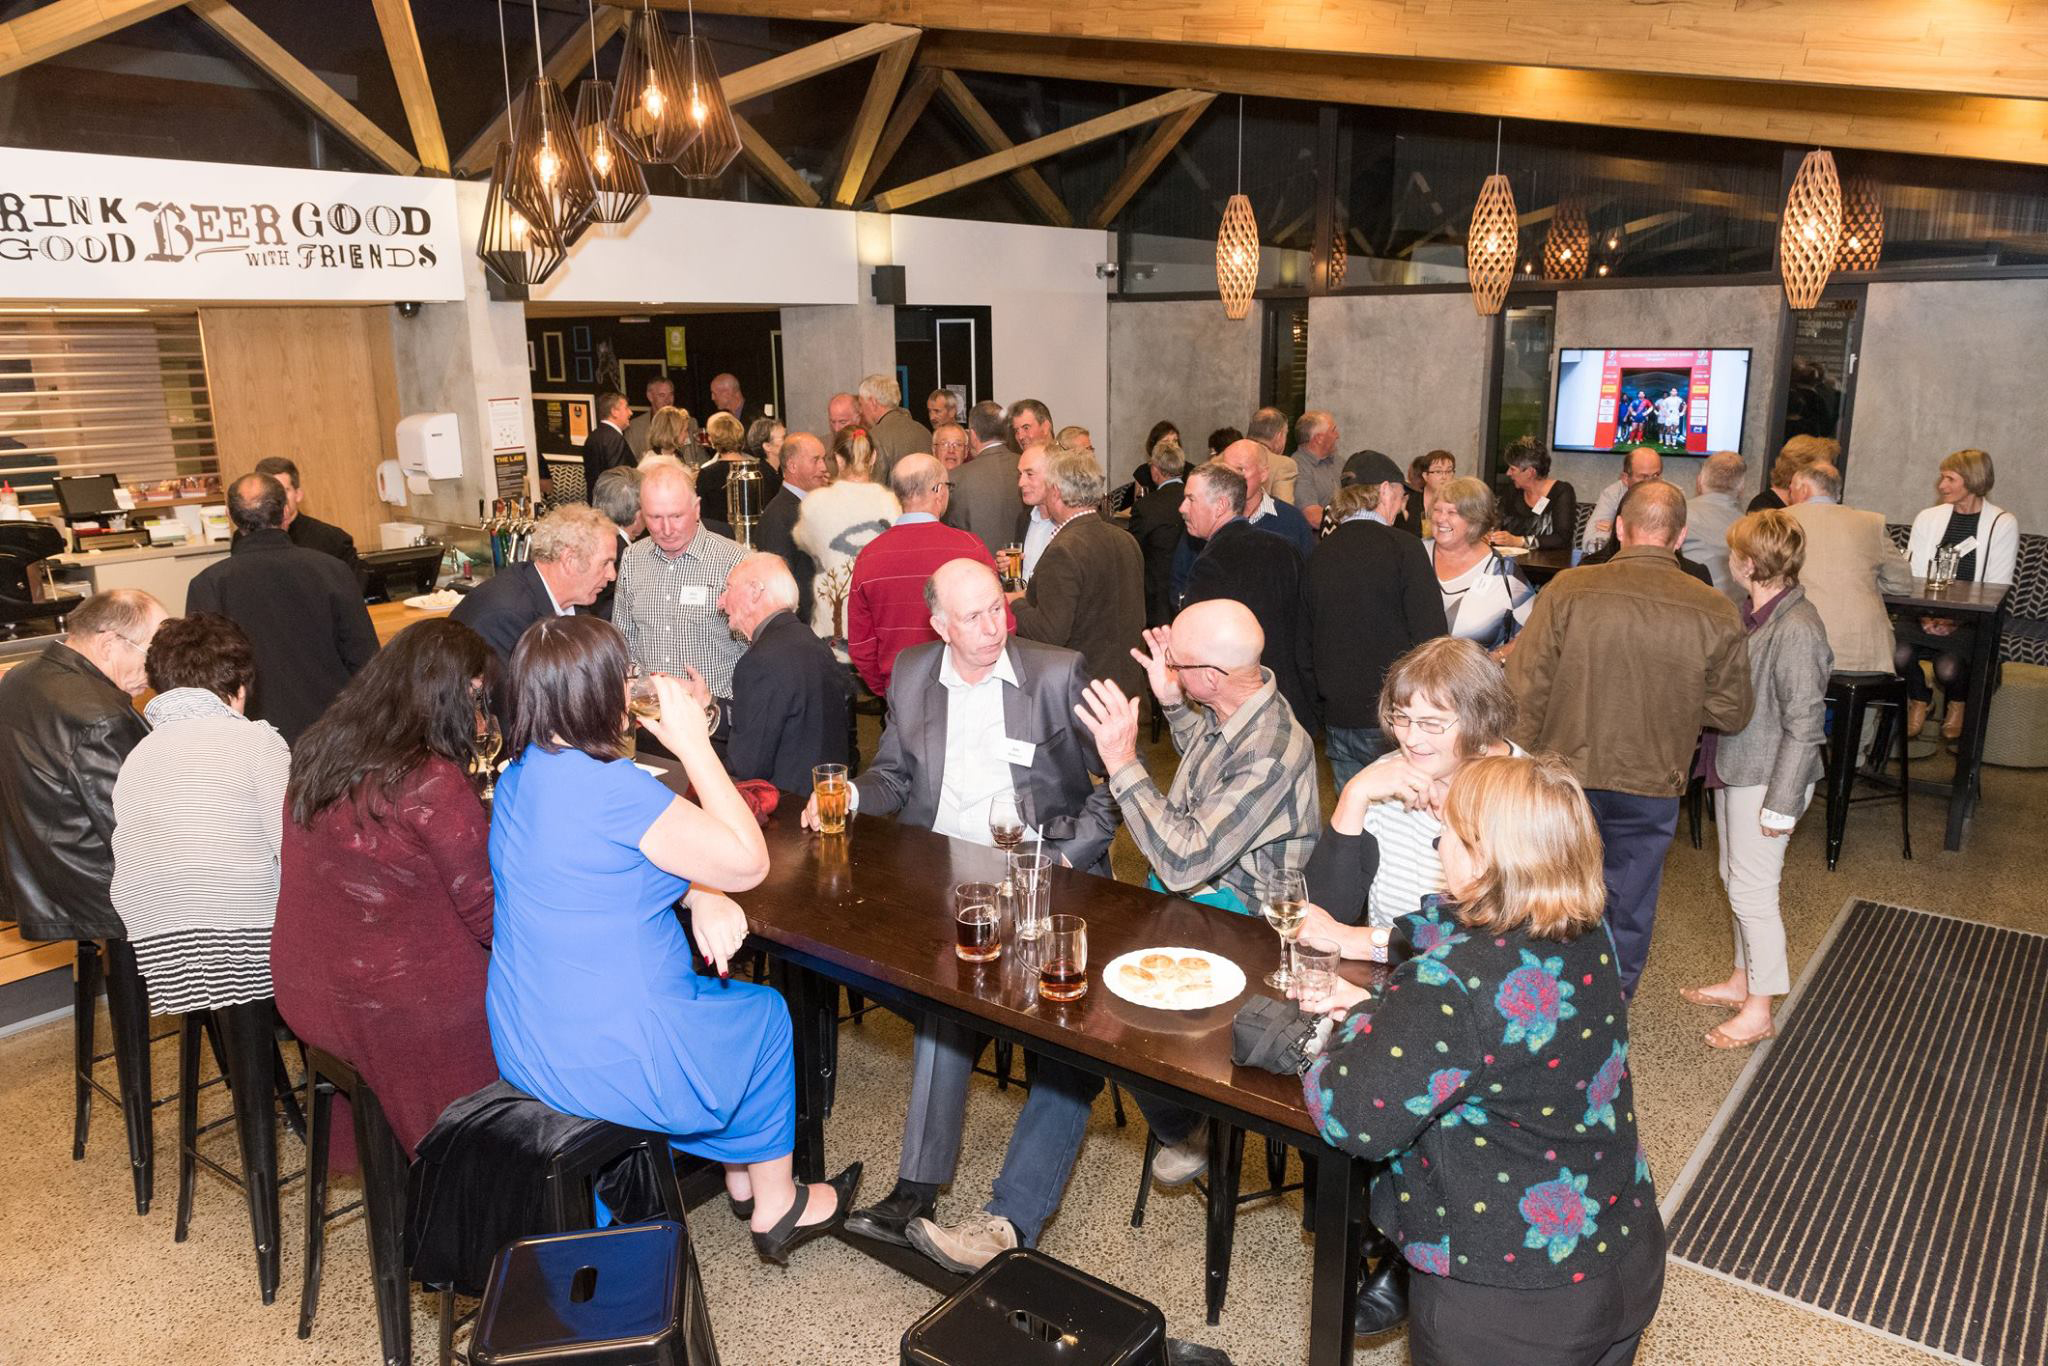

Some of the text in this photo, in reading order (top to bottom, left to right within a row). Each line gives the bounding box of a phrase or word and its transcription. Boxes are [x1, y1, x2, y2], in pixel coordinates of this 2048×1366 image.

[0, 192, 127, 232] RINK
[292, 202, 432, 238] GOOD
[0, 232, 136, 263] GOOD
[135, 201, 287, 263] BEER
[246, 244, 437, 269] WITH FRIENDS
